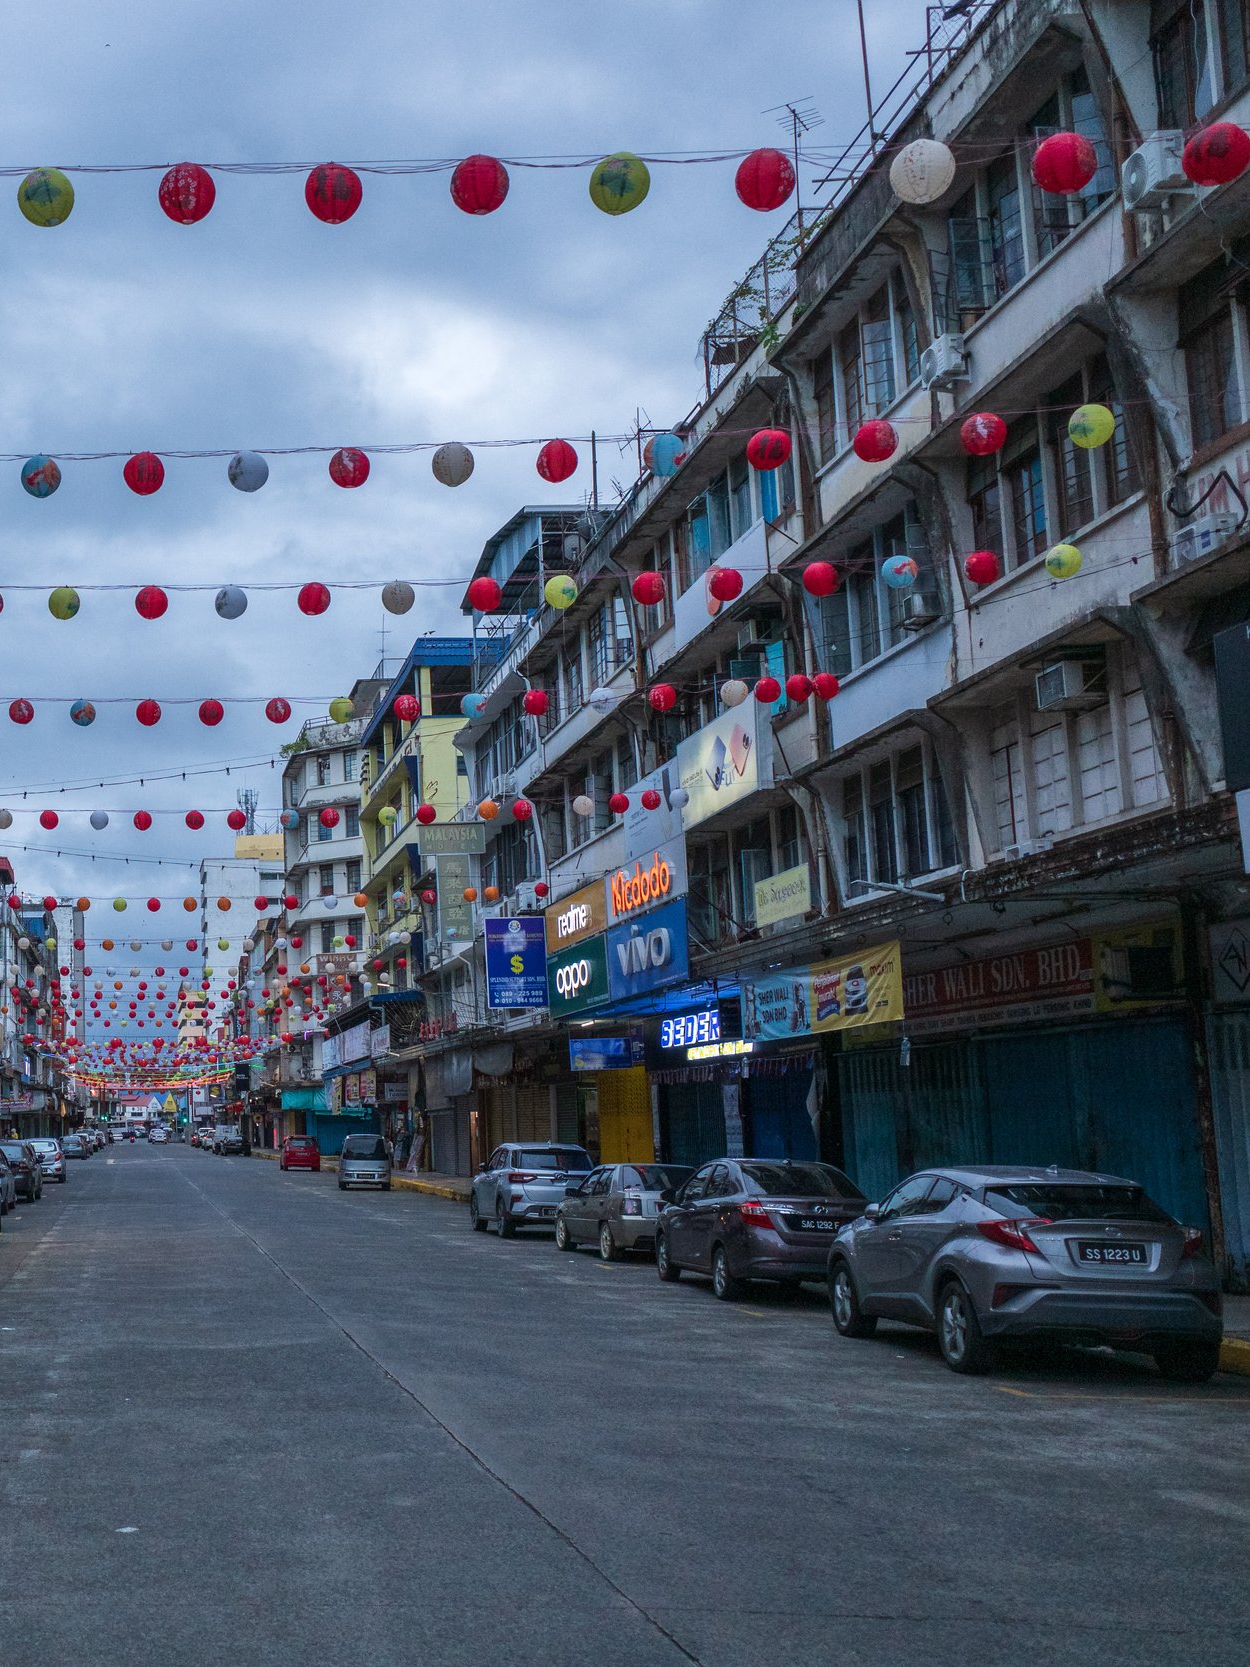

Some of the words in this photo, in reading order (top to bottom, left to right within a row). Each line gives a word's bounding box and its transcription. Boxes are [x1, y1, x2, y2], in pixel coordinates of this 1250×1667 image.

[424, 827, 477, 841] MALAYSIA
[557, 904, 590, 938] realme
[616, 925, 670, 976] vivo
[870, 961, 894, 977] maxim
[942, 962, 985, 1000] WALI
[990, 954, 1030, 992] SDN.
[1037, 945, 1081, 985] BHD
[557, 959, 591, 999] oppo
[758, 990, 773, 1005] SHER
[774, 986, 789, 1002] WALI
[762, 1010, 774, 1024] SDN
[775, 1008, 787, 1022] BHD
[801, 1220, 815, 1229] SAC
[817, 1221, 833, 1229] 1292
[1085, 1248, 1101, 1260] SS
[1104, 1249, 1130, 1261] 1223
[1132, 1250, 1141, 1261] U
